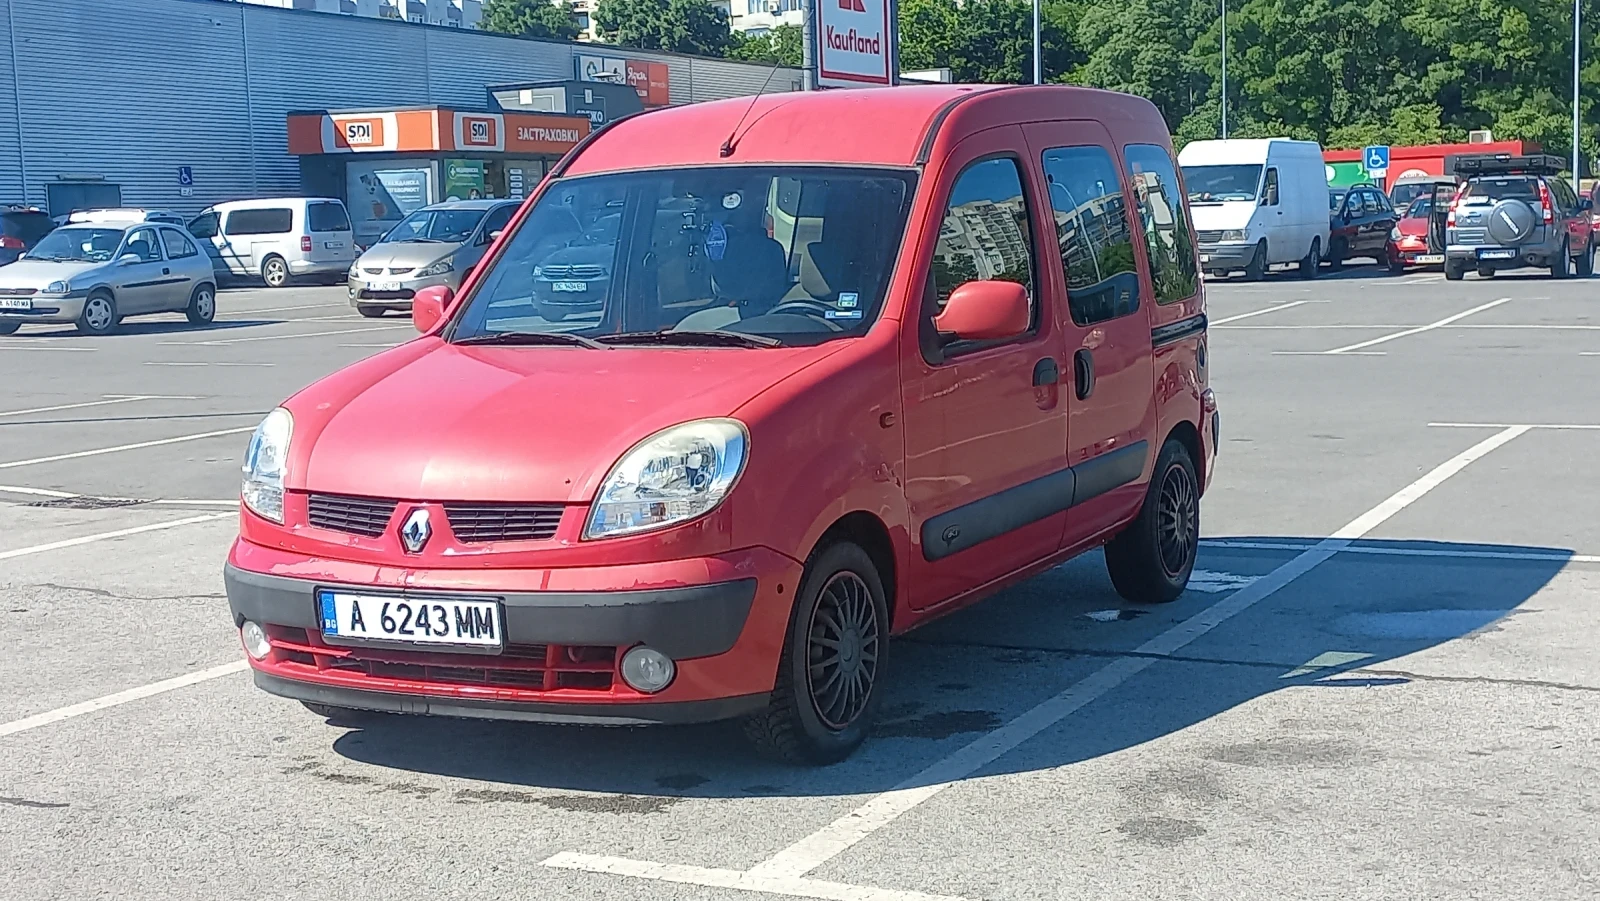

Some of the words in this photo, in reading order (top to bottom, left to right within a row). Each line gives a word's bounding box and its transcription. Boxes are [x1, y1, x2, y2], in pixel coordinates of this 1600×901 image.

[826, 25, 880, 55] Kaufland
[348, 124, 370, 138] SDI
[472, 123, 487, 137] SDI
[517, 127, 579, 142] ЗАСТРАХОВКИ
[325, 618, 337, 629] BG
[351, 600, 366, 632] A
[380, 602, 449, 637] 6243
[454, 605, 495, 639] MM
